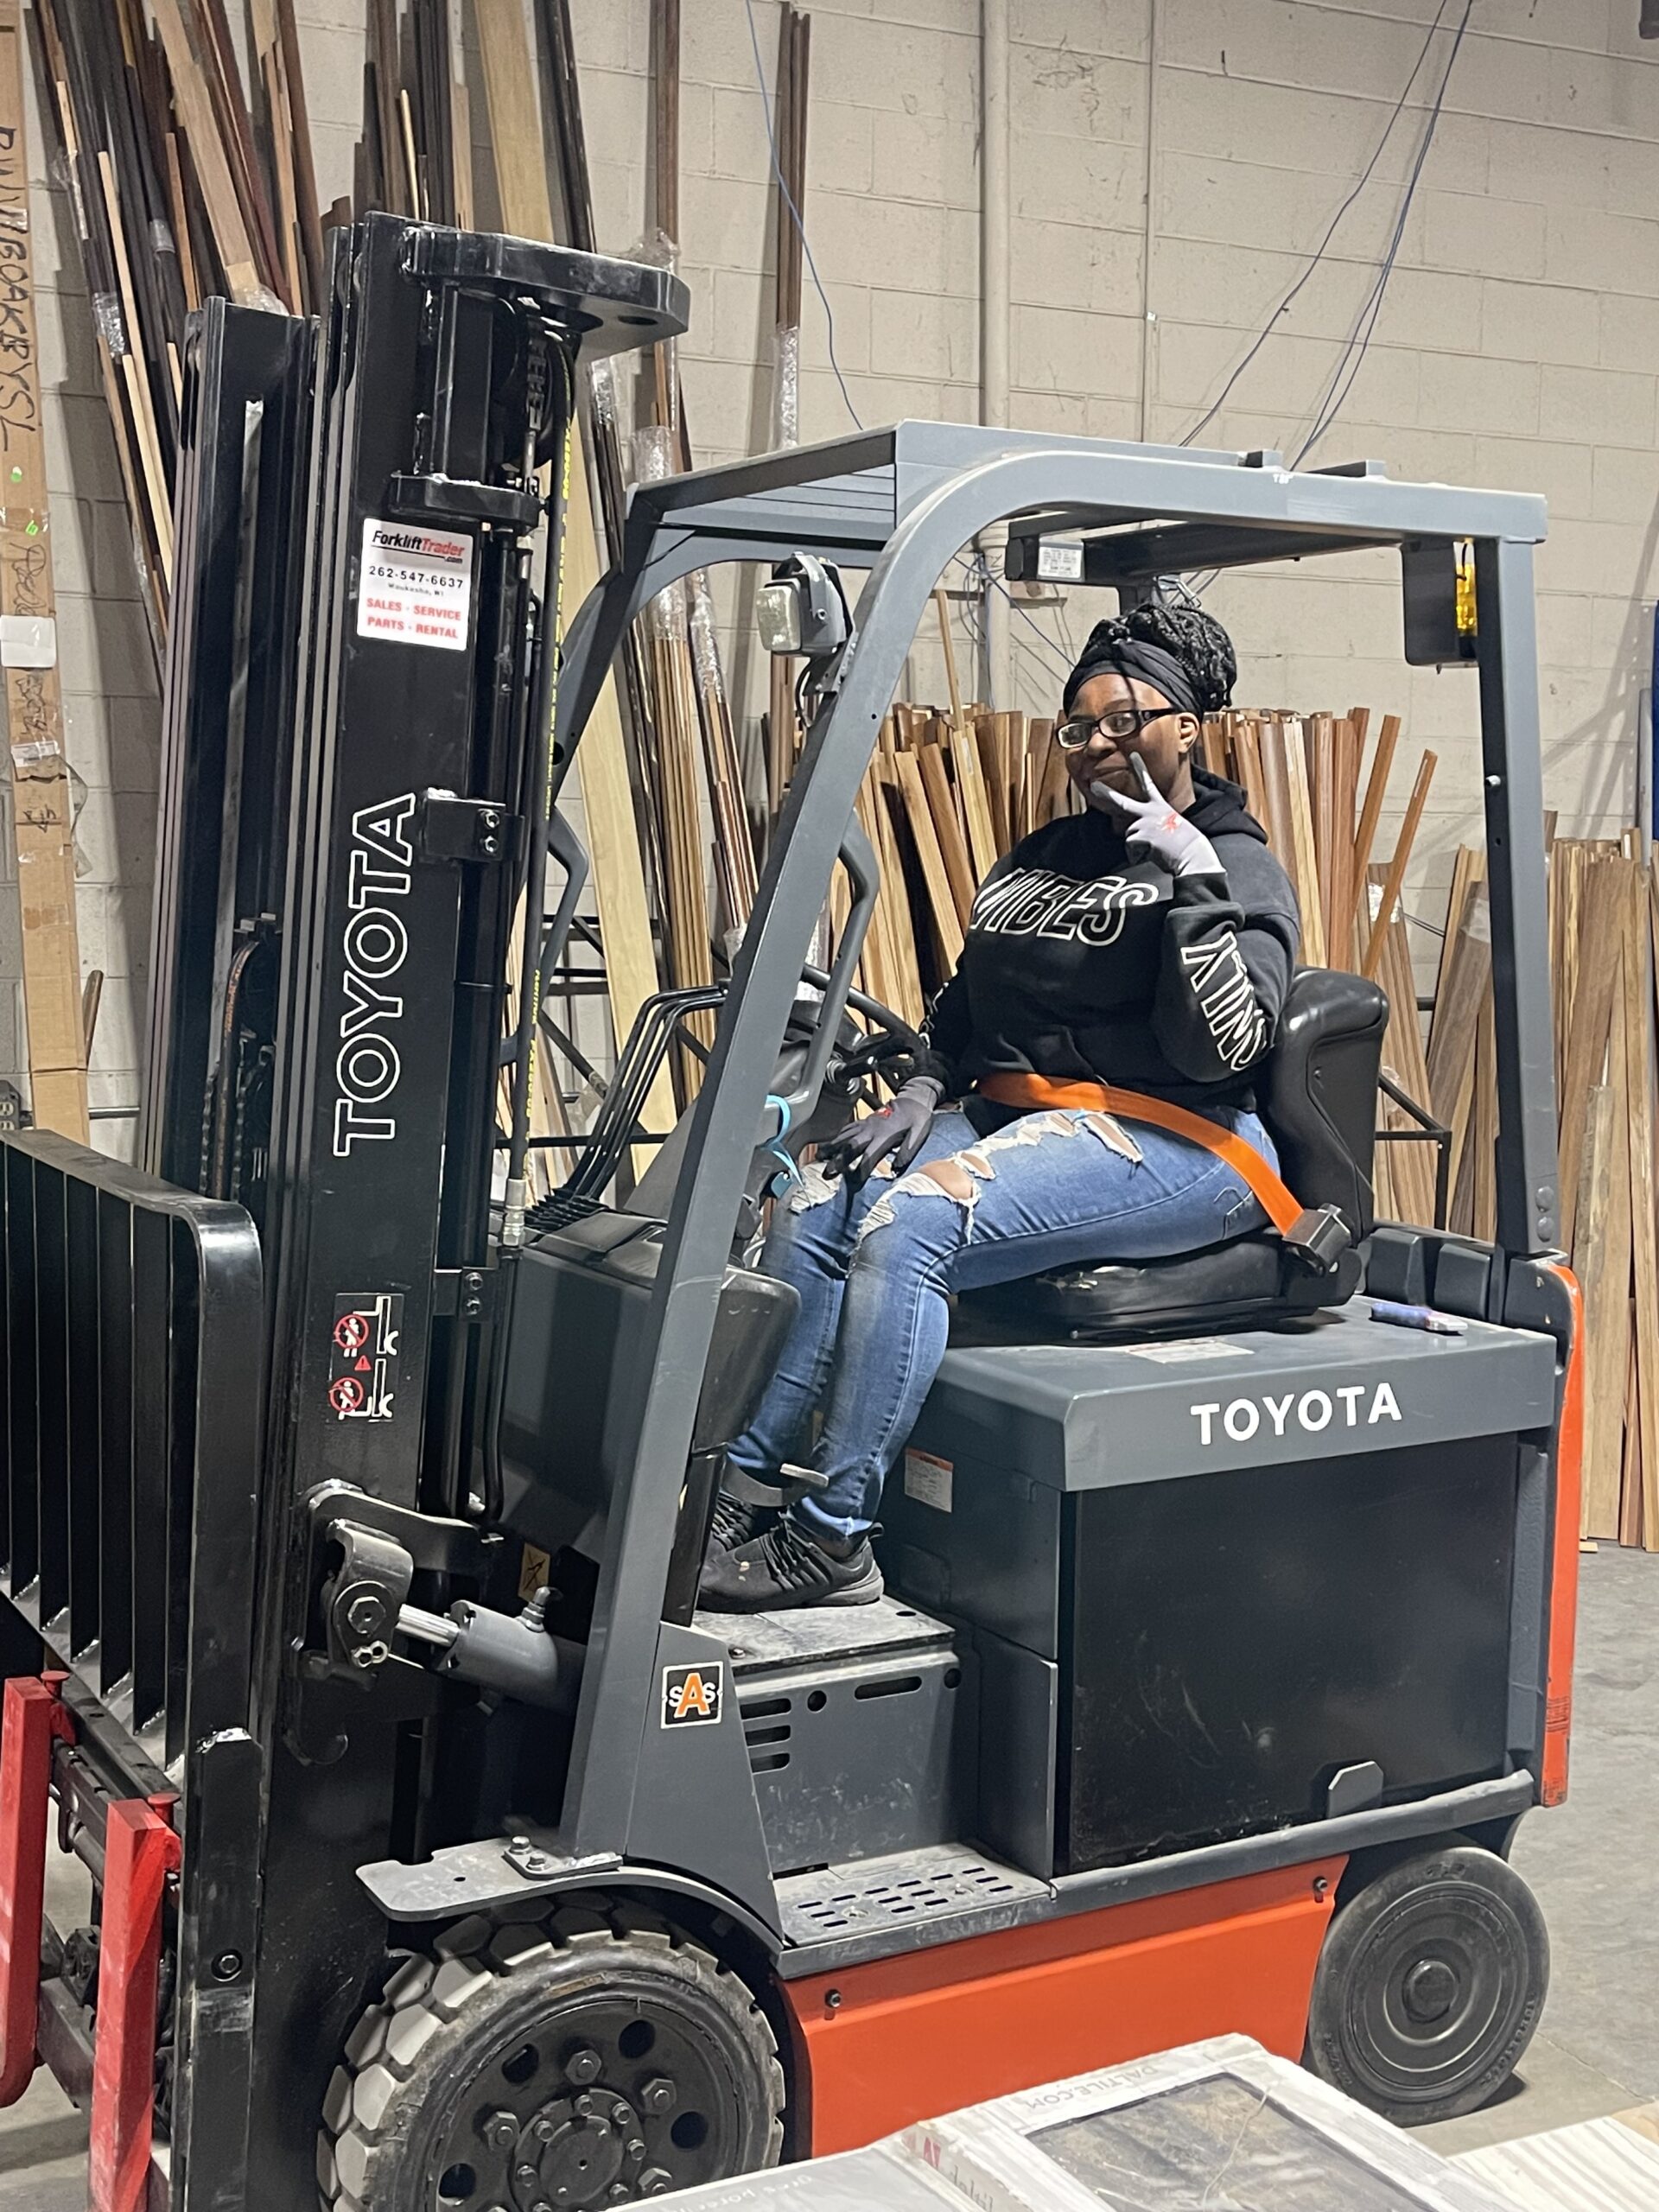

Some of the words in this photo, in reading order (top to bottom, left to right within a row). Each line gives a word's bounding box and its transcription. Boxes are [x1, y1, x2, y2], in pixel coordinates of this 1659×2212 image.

[372, 530, 466, 557] ForkliftTrader
[368, 565, 464, 589] 262-547-6637
[366, 597, 403, 613] SALES
[413, 604, 461, 621] SERVICE
[366, 616, 405, 632] PARTS
[415, 623, 459, 639] RENTAL
[333, 792, 416, 1158] TOYOTA
[1190, 1382, 1403, 1446] TOYOTA
[668, 1672, 716, 1719] SAS
[1025, 2065, 1159, 2109] DALTILE.COM
